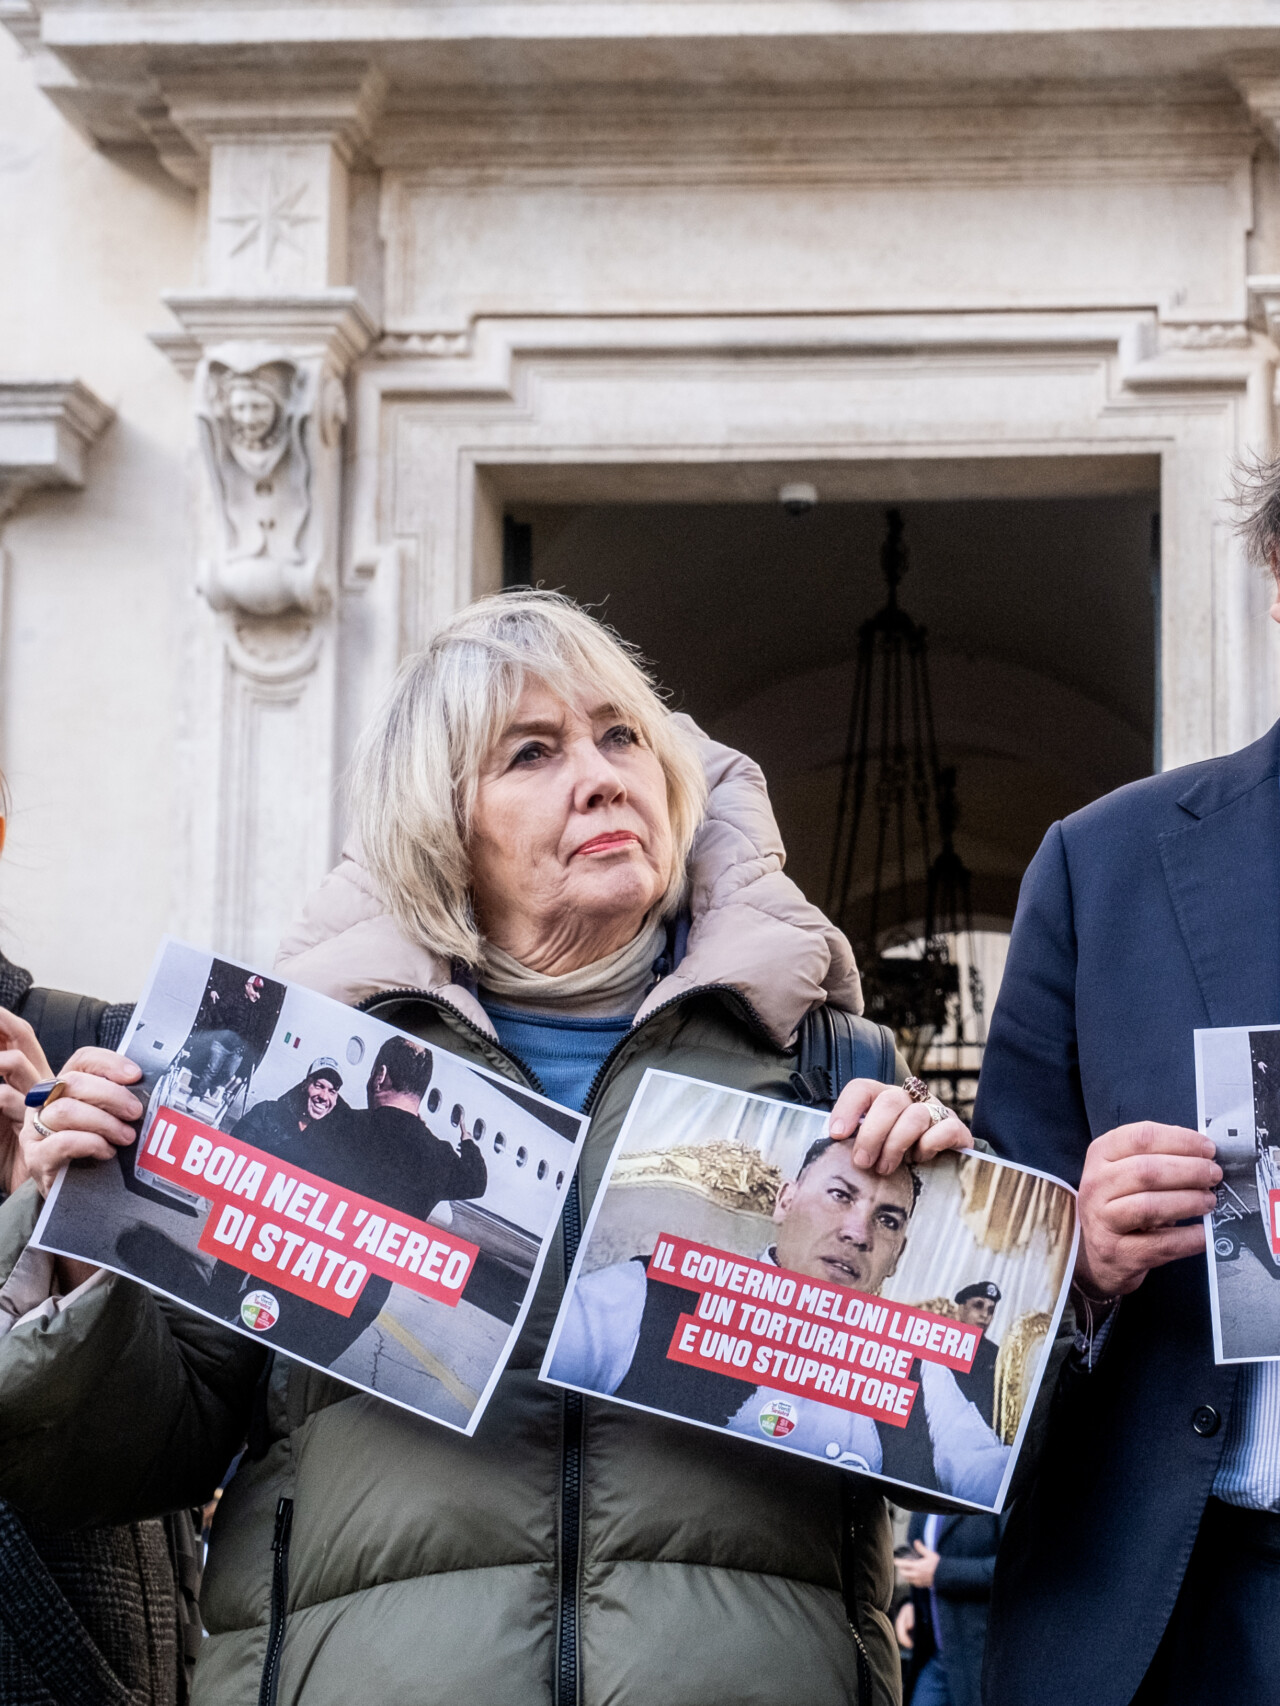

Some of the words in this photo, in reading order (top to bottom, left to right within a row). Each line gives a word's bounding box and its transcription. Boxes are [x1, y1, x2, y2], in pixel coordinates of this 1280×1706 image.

[147, 1118, 178, 1165] IL
[181, 1135, 267, 1201] BOIA
[261, 1172, 470, 1290] NELL'AEREO
[213, 1205, 256, 1251] DI
[252, 1223, 367, 1300] STATO
[653, 1241, 676, 1272] IL
[681, 1250, 796, 1306] GOVERNO
[796, 1284, 889, 1334] MELONI
[888, 1312, 976, 1361] LIBERA
[699, 1292, 736, 1326] UN
[739, 1303, 912, 1378] TORTURATORE
[679, 1324, 700, 1352] E
[700, 1329, 752, 1367] UNO
[752, 1346, 914, 1416] STUPRATORE
